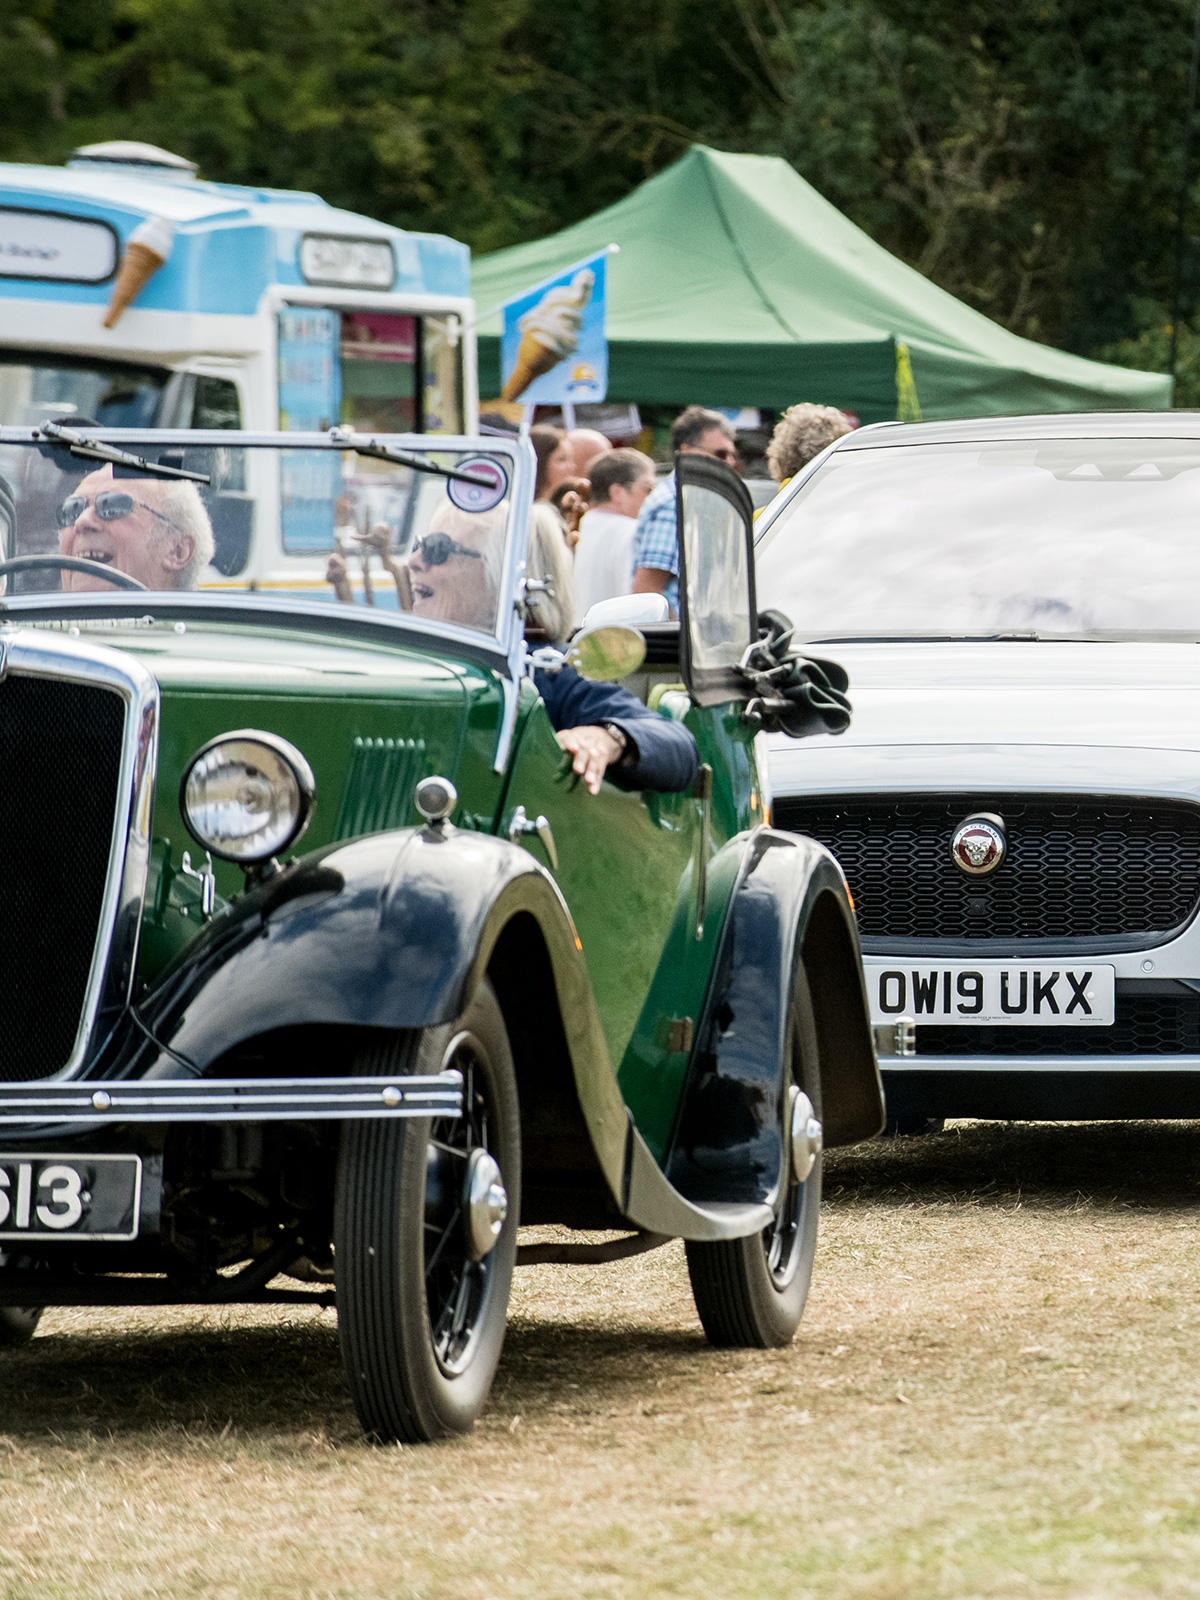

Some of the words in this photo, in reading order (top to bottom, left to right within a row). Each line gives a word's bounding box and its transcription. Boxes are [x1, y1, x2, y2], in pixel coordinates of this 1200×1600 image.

[959, 824, 998, 838] JAGUAR
[879, 971, 984, 1014] OW19
[1000, 971, 1093, 1015] UKX
[0, 1163, 82, 1229] 13
